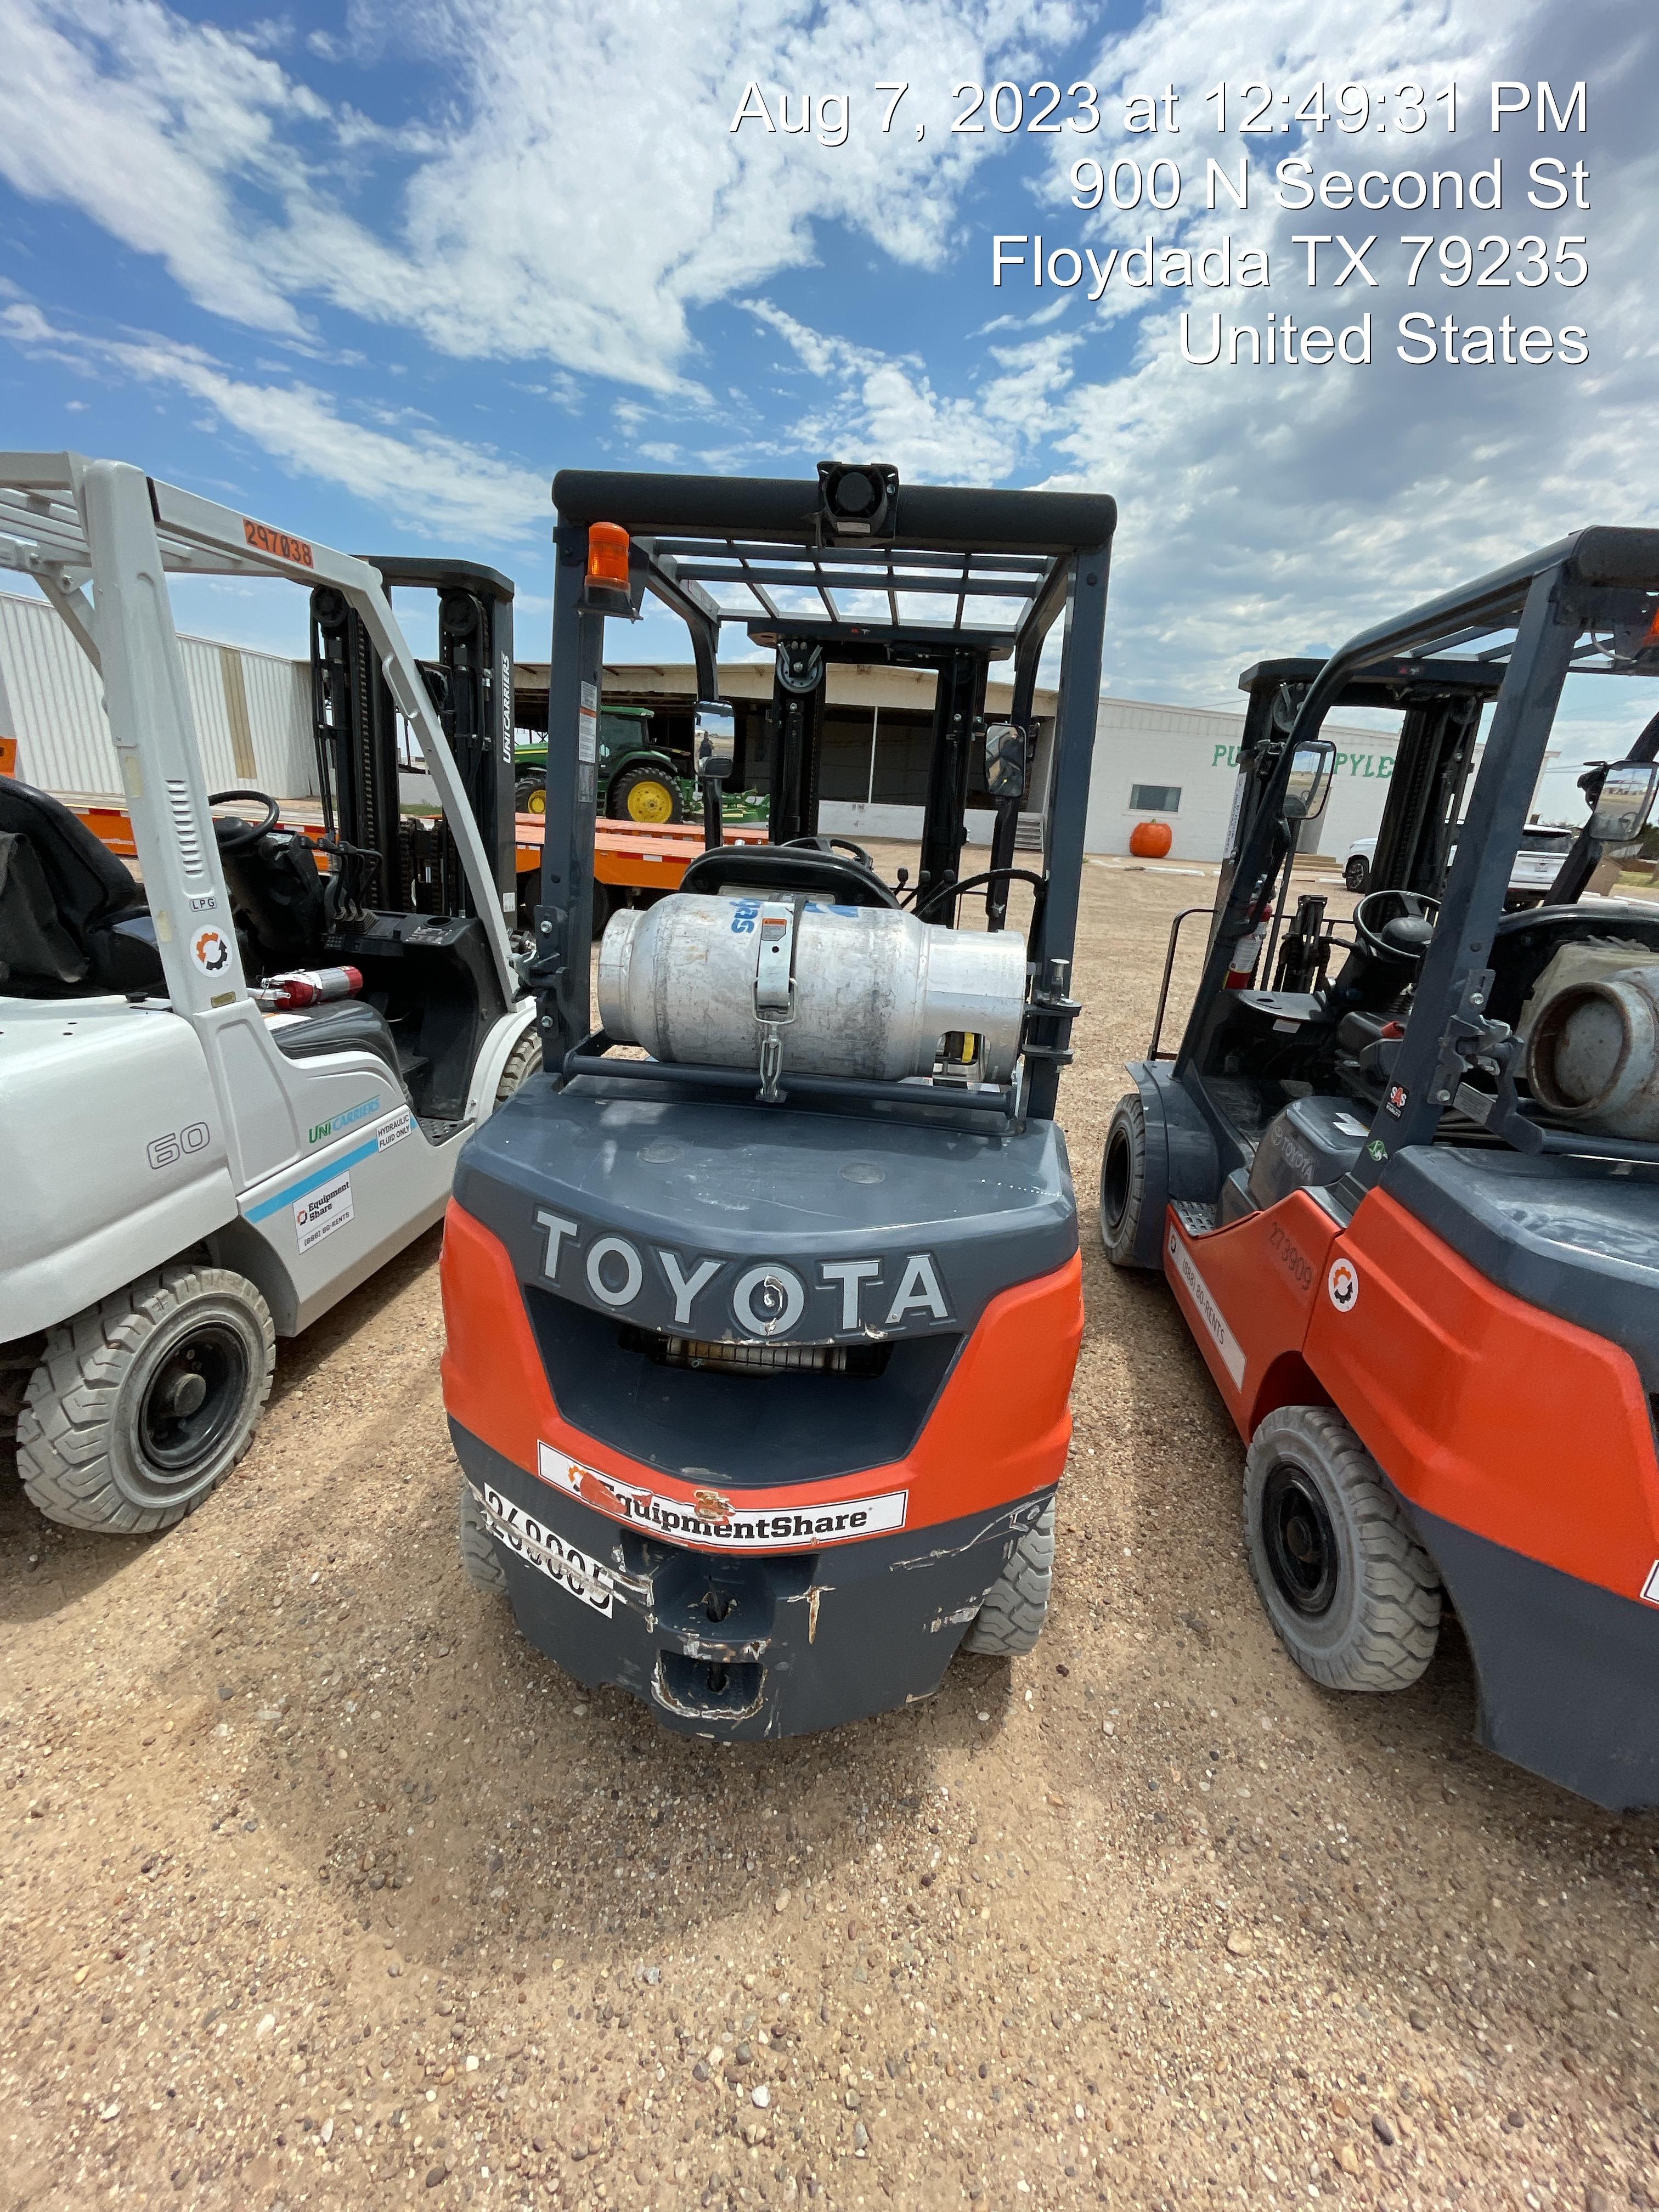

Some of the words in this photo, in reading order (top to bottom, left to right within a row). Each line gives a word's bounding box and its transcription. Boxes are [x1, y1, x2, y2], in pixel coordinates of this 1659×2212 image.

[246, 520, 311, 566] 297038
[192, 898, 215, 910] LPG
[146, 1121, 210, 1170] 60
[377, 1114, 410, 1138] HYDRAULIC
[379, 1133, 395, 1148] FLUID
[396, 1124, 410, 1138] ONLY
[308, 1181, 350, 1213] Equipment
[309, 1203, 332, 1222] Share
[537, 1210, 948, 1336] TOYOTA
[1182, 1258, 1196, 1291] (888)
[1196, 1284, 1224, 1345] 80-RENTS
[597, 1479, 867, 1539] quipmentShare
